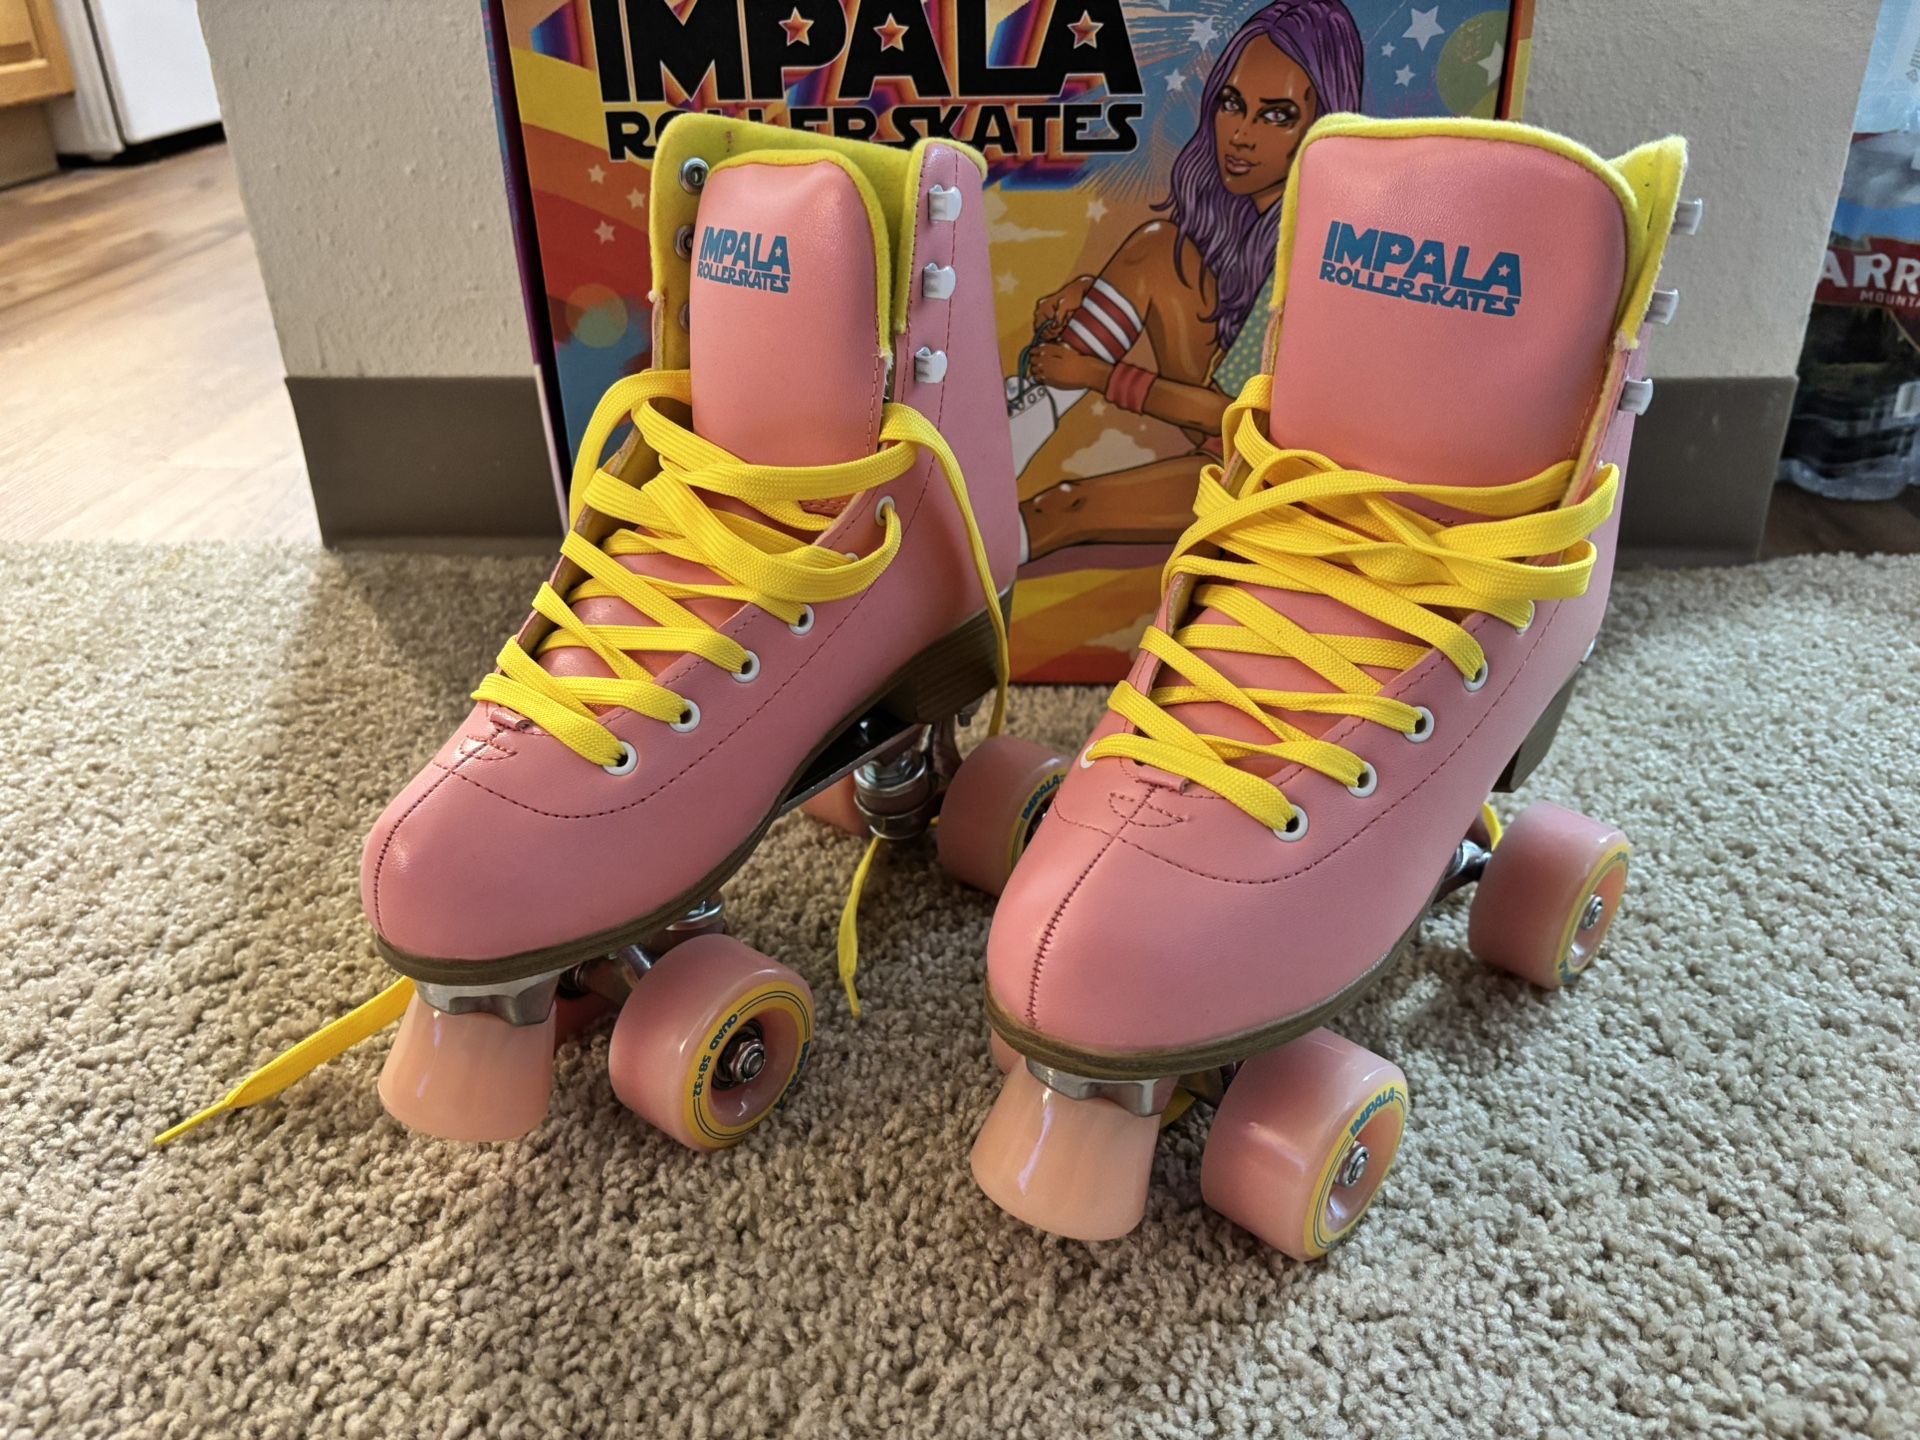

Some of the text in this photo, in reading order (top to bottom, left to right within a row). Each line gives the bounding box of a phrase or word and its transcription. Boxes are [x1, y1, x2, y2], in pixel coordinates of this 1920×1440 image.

[587, 0, 1143, 103] IMPALA
[697, 260, 790, 294] ROLLERSKATES
[699, 225, 791, 275] IMPALA
[1322, 220, 1522, 297] IMPALA
[1319, 260, 1520, 317] ROLLERSKATES
[1350, 1086, 1395, 1137] IMPALA
